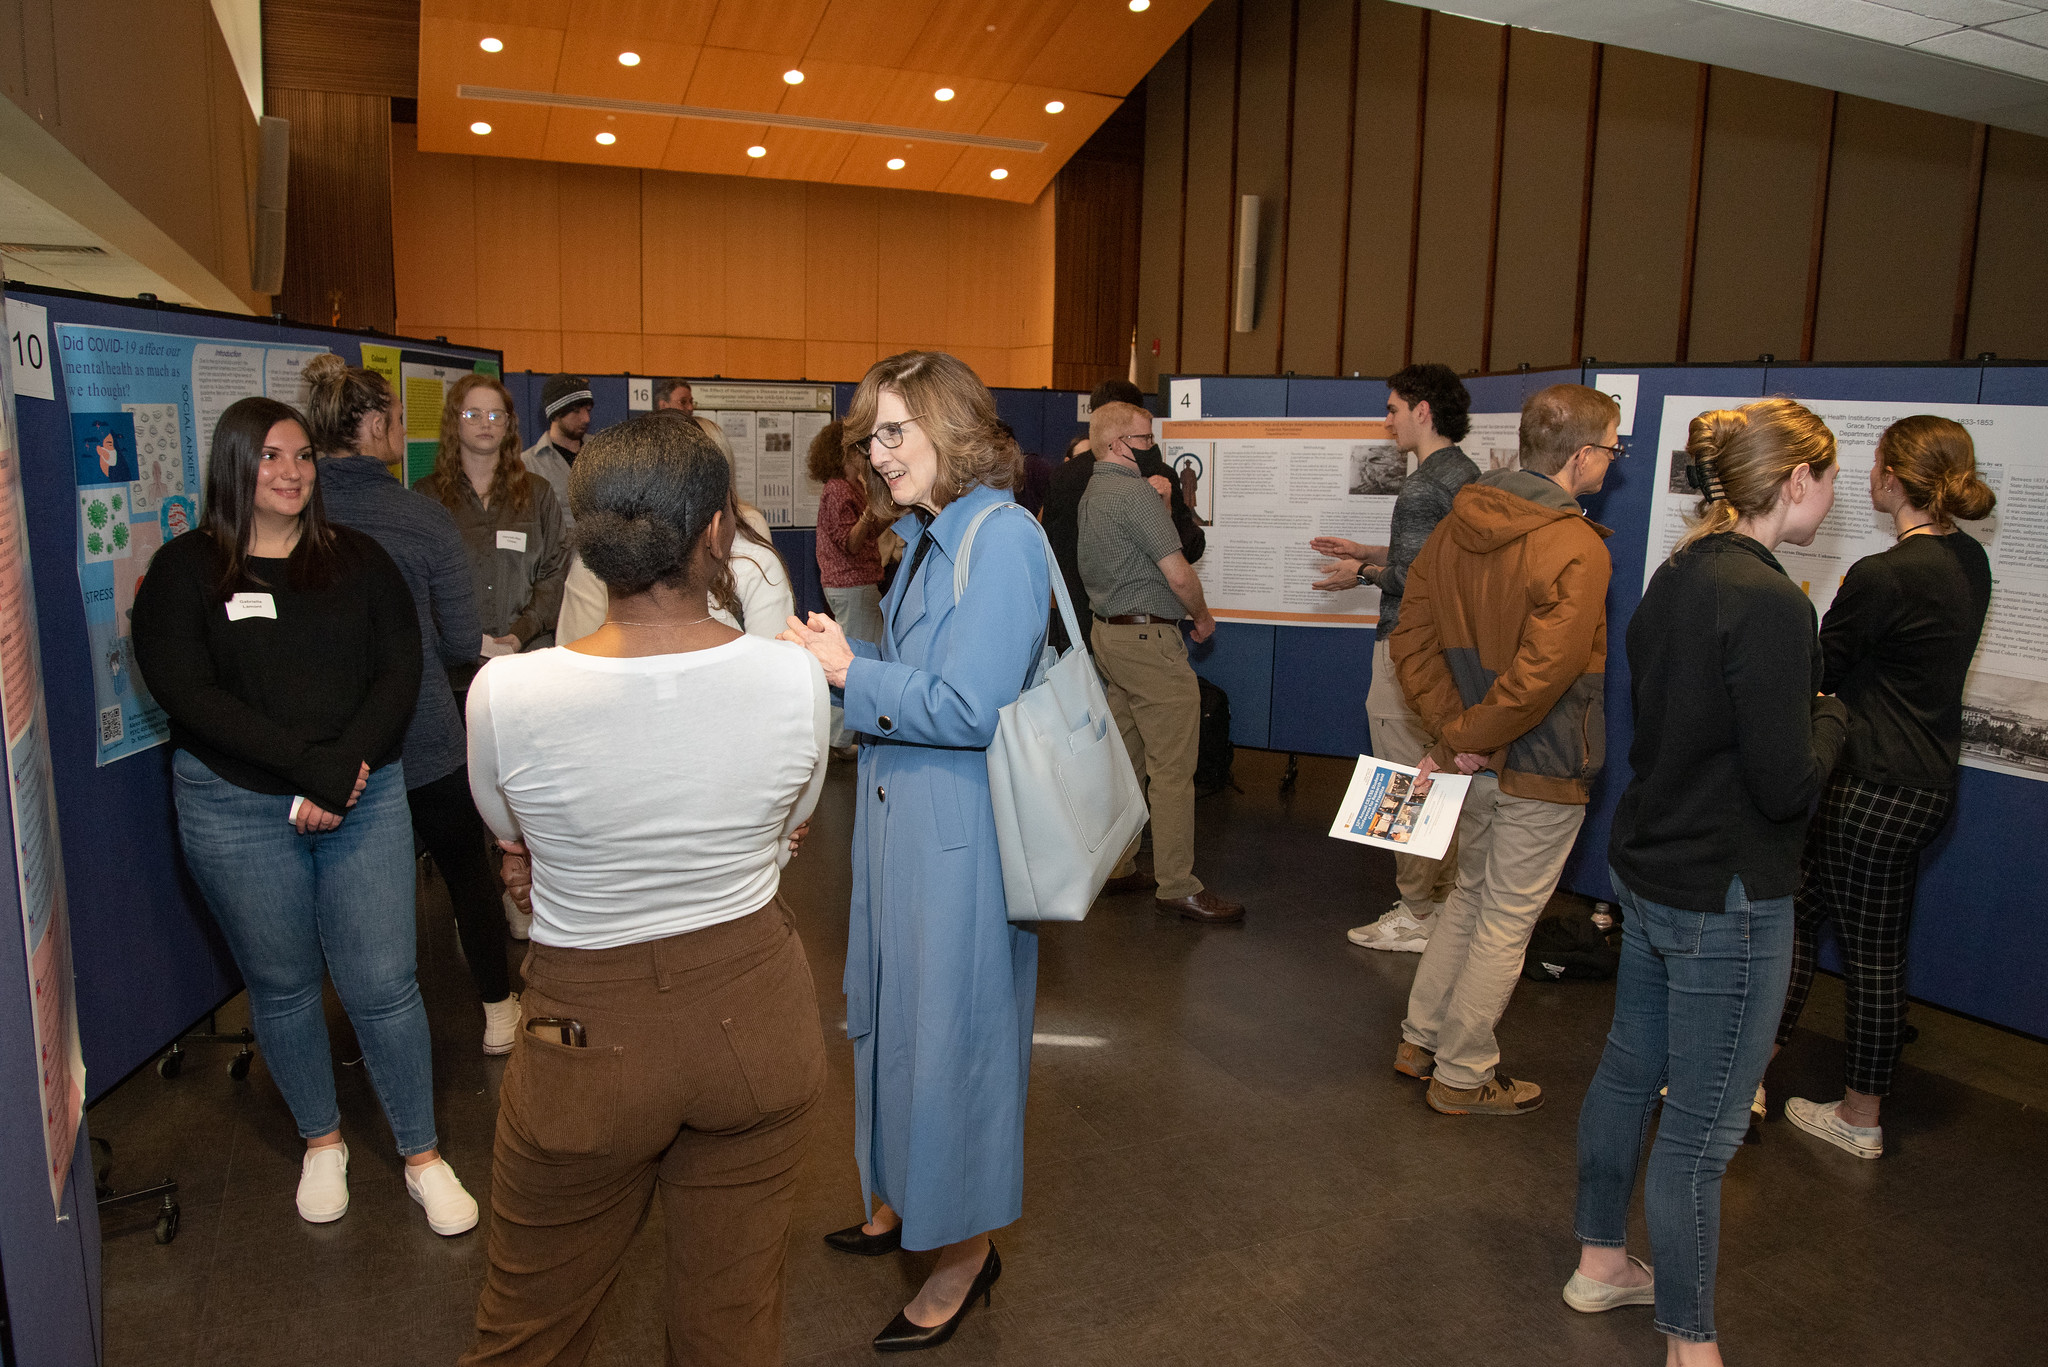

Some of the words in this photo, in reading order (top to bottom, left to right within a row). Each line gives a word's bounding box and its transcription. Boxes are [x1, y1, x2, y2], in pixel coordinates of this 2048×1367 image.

[12, 331, 42, 369] 10
[63, 336, 83, 350] Did
[88, 336, 136, 353] COVID-19
[139, 343, 164, 356] affect
[166, 347, 181, 357] our
[135, 366, 144, 376] as
[147, 366, 169, 377] much
[172, 368, 180, 377] as
[67, 386, 83, 397] we
[88, 383, 130, 400] thought?
[633, 389, 649, 402] 16
[182, 384, 191, 430] SOCIAL
[1081, 404, 1093, 414] 18
[1180, 393, 1191, 408] 4
[186, 436, 195, 485] ANXIETY
[85, 588, 113, 605] STRESS
